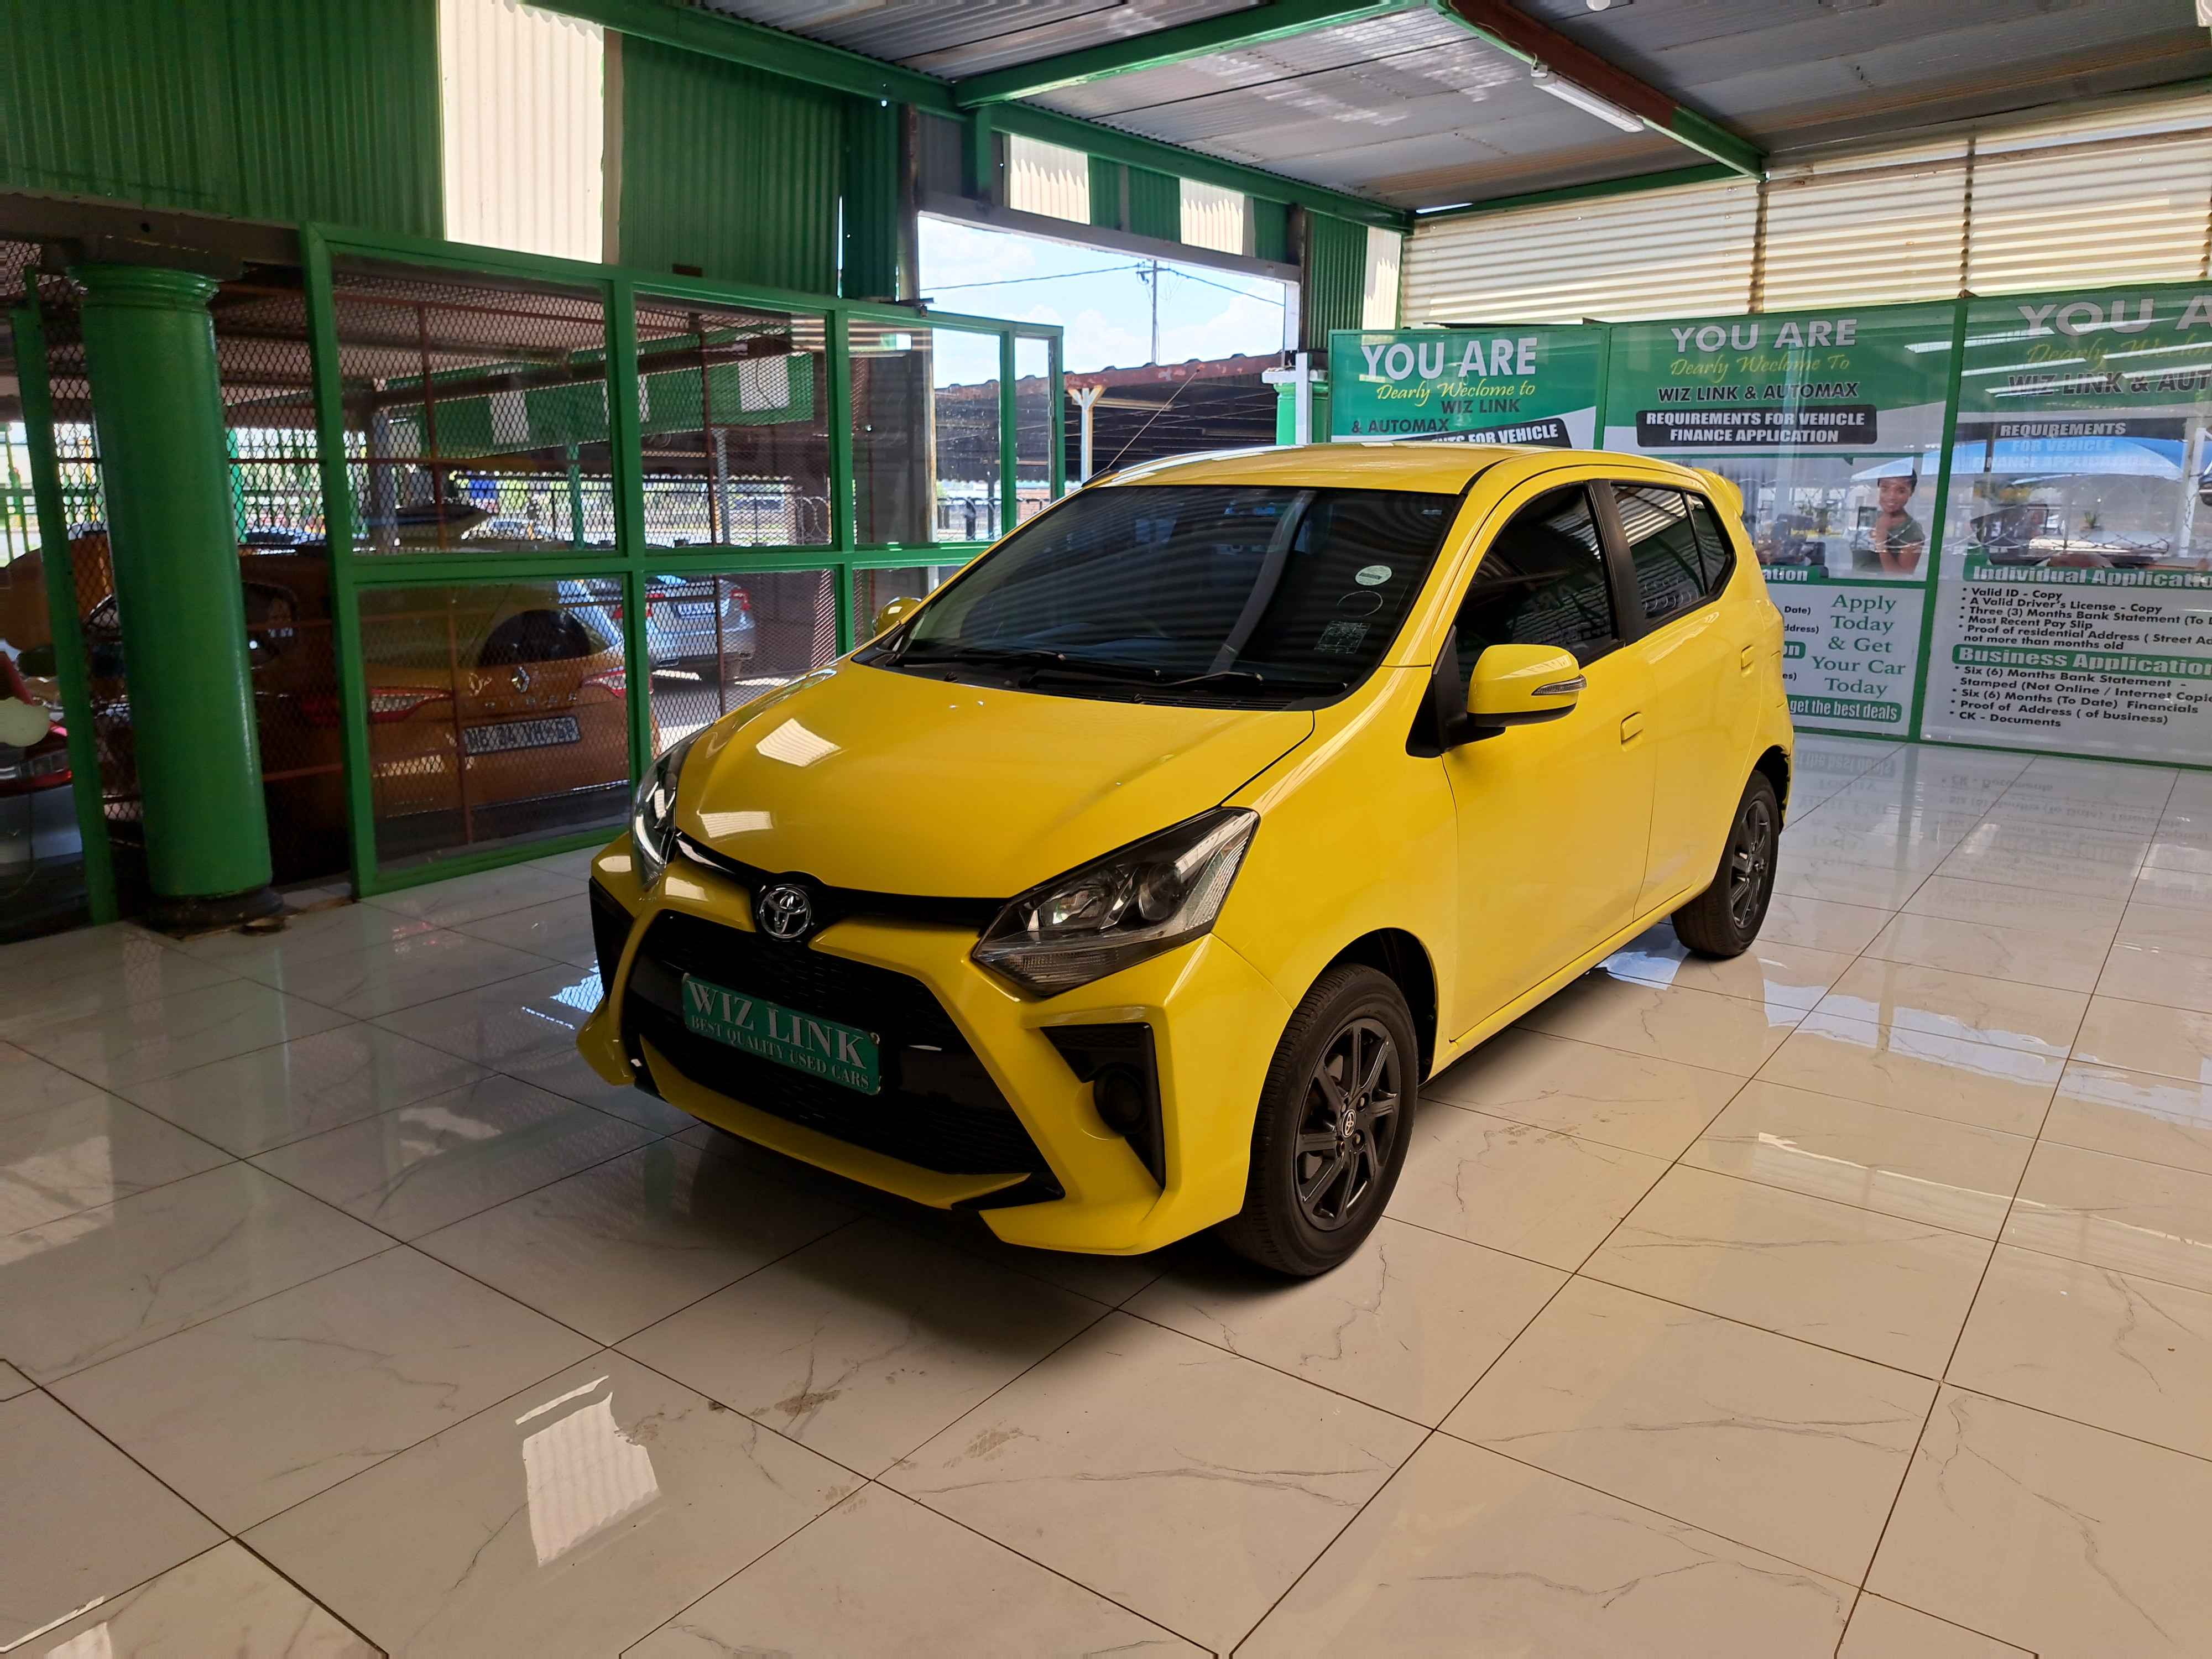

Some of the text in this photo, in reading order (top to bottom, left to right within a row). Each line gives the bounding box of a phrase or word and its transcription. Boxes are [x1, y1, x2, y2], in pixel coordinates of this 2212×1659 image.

[2017, 296, 2154, 336] YOU
[1671, 319, 1857, 353] YOU ARE
[1360, 337, 1537, 380] YOU ARE
[1671, 354, 1729, 383] Dearly
[1828, 354, 1850, 369] To
[1376, 380, 1431, 406] Dearly
[1520, 379, 1536, 395] to
[1658, 382, 1860, 403] WIZ LINK & AUTOMAX
[2062, 372, 2123, 395] LINK
[2129, 374, 2152, 394] &
[1442, 399, 1521, 414] WIZ LINK
[1352, 418, 1449, 434] & AUTOMAX
[1646, 413, 1865, 426] REQUIREMENTS FOR VEHICLE
[1500, 424, 1558, 443] VEHICLE
[1670, 429, 1839, 442] FINANCE APPLICATION
[2000, 422, 2127, 438] REQUIREMENTS
[2047, 439, 2116, 452] VEHICLE
[1973, 566, 2087, 583] Individual
[1832, 594, 1897, 614] Apply
[1972, 588, 2002, 596] Valid
[2033, 590, 2063, 601] Copy
[1784, 606, 1811, 615] Date)
[1983, 597, 2013, 606] Valid
[2018, 599, 2065, 609] Driver's
[2070, 601, 2116, 611] License
[2131, 603, 2162, 614] Copy
[1830, 615, 1895, 635] Today
[1968, 615, 2093, 630] Most Recent Pay Slip
[1970, 606, 2003, 615] Three
[2007, 608, 2023, 618] (3)
[2027, 609, 2072, 619] Months
[2077, 611, 2109, 620] Bank
[2113, 612, 2180, 624] Statement
[2185, 615, 2204, 625] (To
[1967, 625, 1999, 634] Proof
[2018, 628, 2084, 638] residential
[2088, 630, 2140, 641] Address
[2153, 634, 2192, 644] Street
[2022, 637, 2049, 646] than
[2054, 639, 2099, 649] months
[2104, 641, 2124, 650] old
[1828, 637, 1894, 653] & Get
[1812, 656, 1906, 675] Your Car
[1959, 647, 2068, 667] Business
[1964, 666, 1982, 675] Six
[1986, 668, 2003, 678] (6)
[2007, 669, 2055, 680] Months
[2060, 672, 2095, 682] Bank
[2100, 675, 2172, 687] Statement
[1824, 677, 1889, 699] Today
[1960, 677, 2017, 689] Stamped
[2022, 681, 2050, 691] (Not
[2055, 684, 2100, 695] Online
[2115, 687, 2172, 699] Internet
[1790, 700, 1897, 721] get the best deals
[1961, 689, 2199, 714] Six (6) Months (To Date) Financials
[1959, 712, 1976, 720] CK
[1990, 714, 2061, 727] Documents
[1960, 700, 1994, 710] Proof
[2018, 705, 2072, 716] Address
[2085, 709, 2099, 718] of
[2103, 711, 2168, 726] business)
[688, 980, 867, 1070] WIZ LINK
[692, 1015, 869, 1090] BEST QUALITY USED CARS
